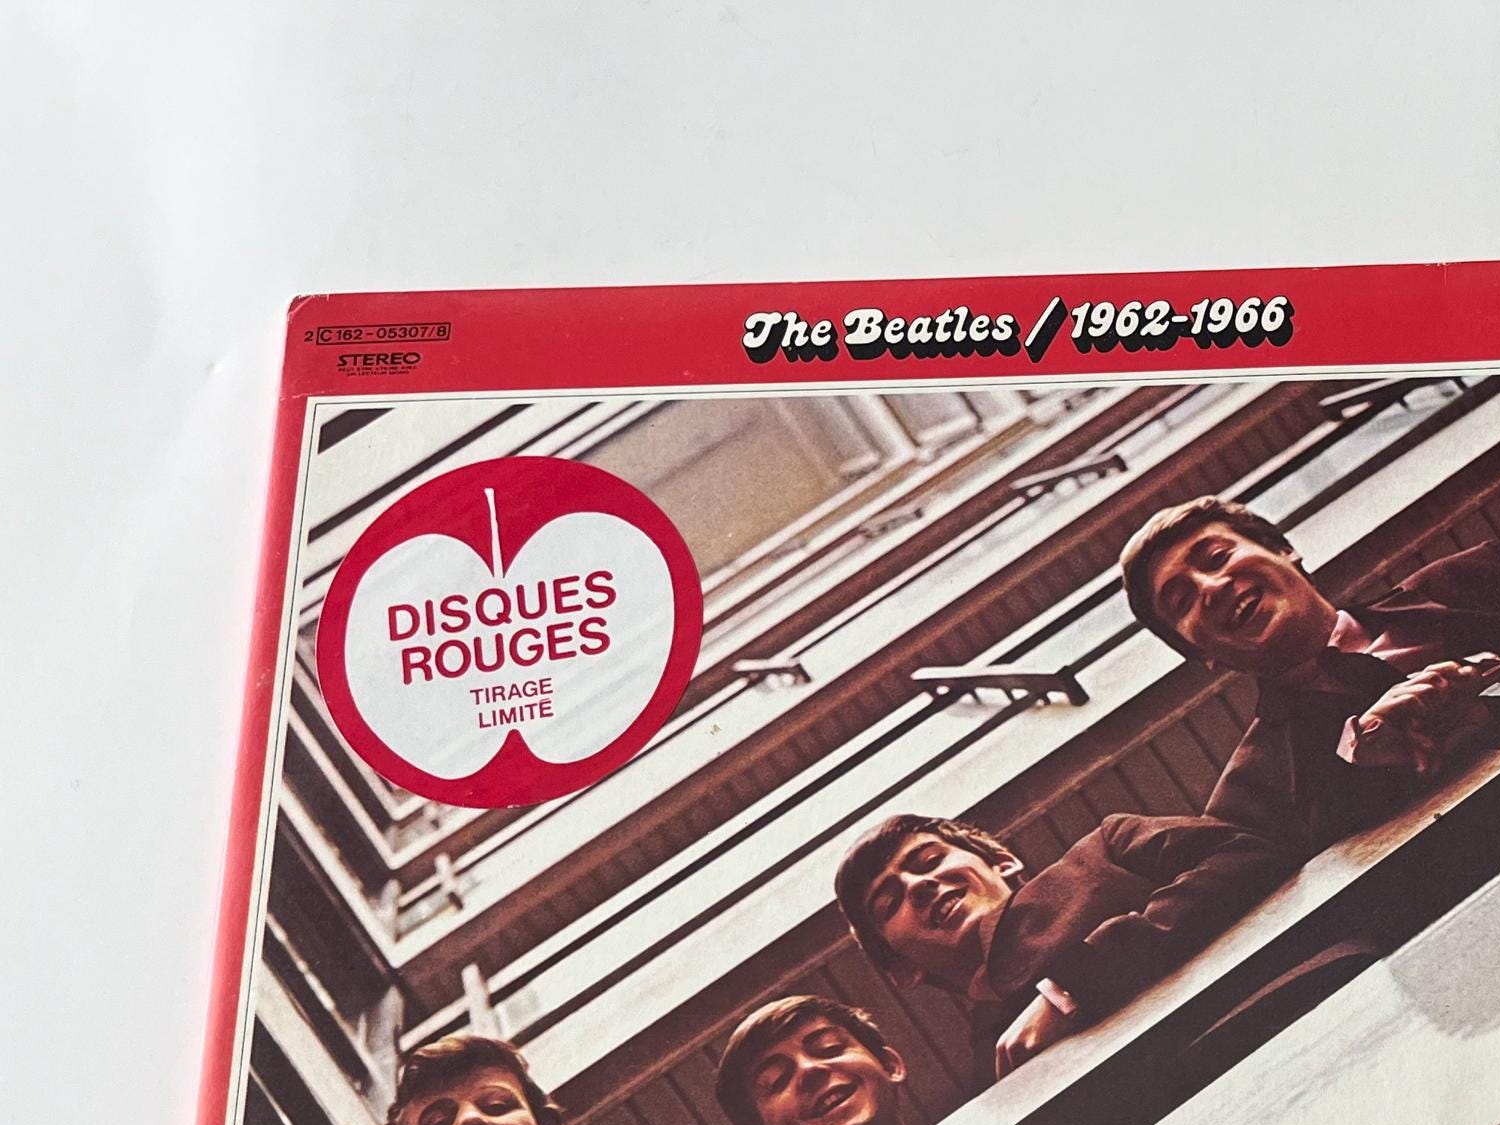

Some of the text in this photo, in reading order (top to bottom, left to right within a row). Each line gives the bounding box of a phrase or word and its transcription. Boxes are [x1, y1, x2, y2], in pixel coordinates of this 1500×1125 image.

[304, 330, 314, 342] 2
[320, 329, 332, 342] C
[742, 311, 837, 361] The
[843, 305, 1019, 359] Beatles
[1071, 296, 1294, 352] 1962-1966
[337, 352, 421, 367] STEREO
[387, 569, 617, 642] DISQUES
[401, 616, 612, 686] ROUGES
[470, 677, 554, 706] TIRAGE
